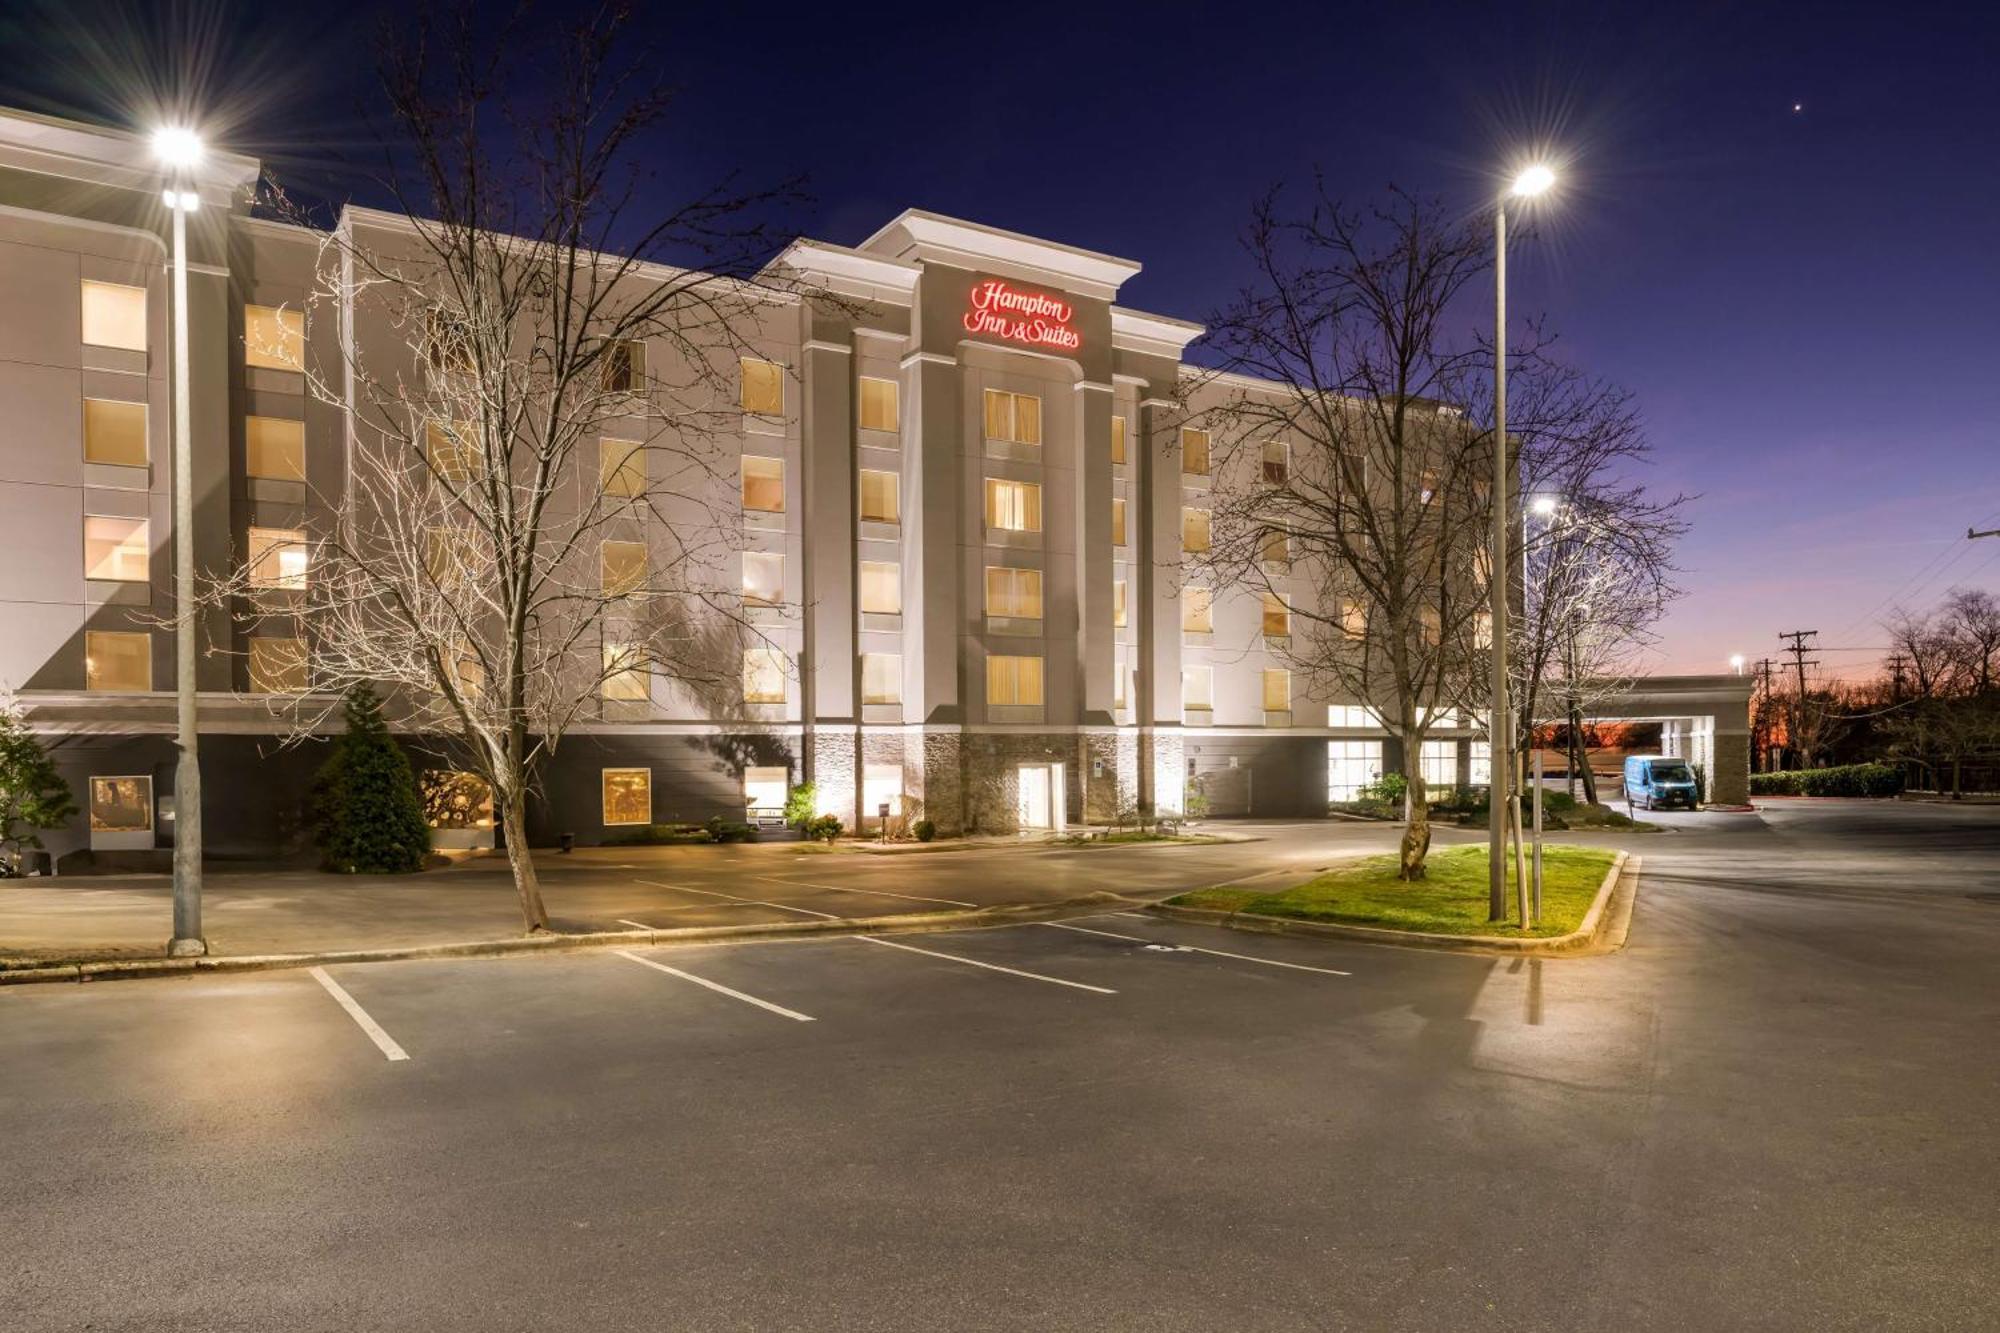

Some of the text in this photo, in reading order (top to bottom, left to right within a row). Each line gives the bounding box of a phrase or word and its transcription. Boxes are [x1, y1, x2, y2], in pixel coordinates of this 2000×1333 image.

[971, 282, 1072, 322] Hampton
[963, 309, 1079, 348] Inn & Suites
